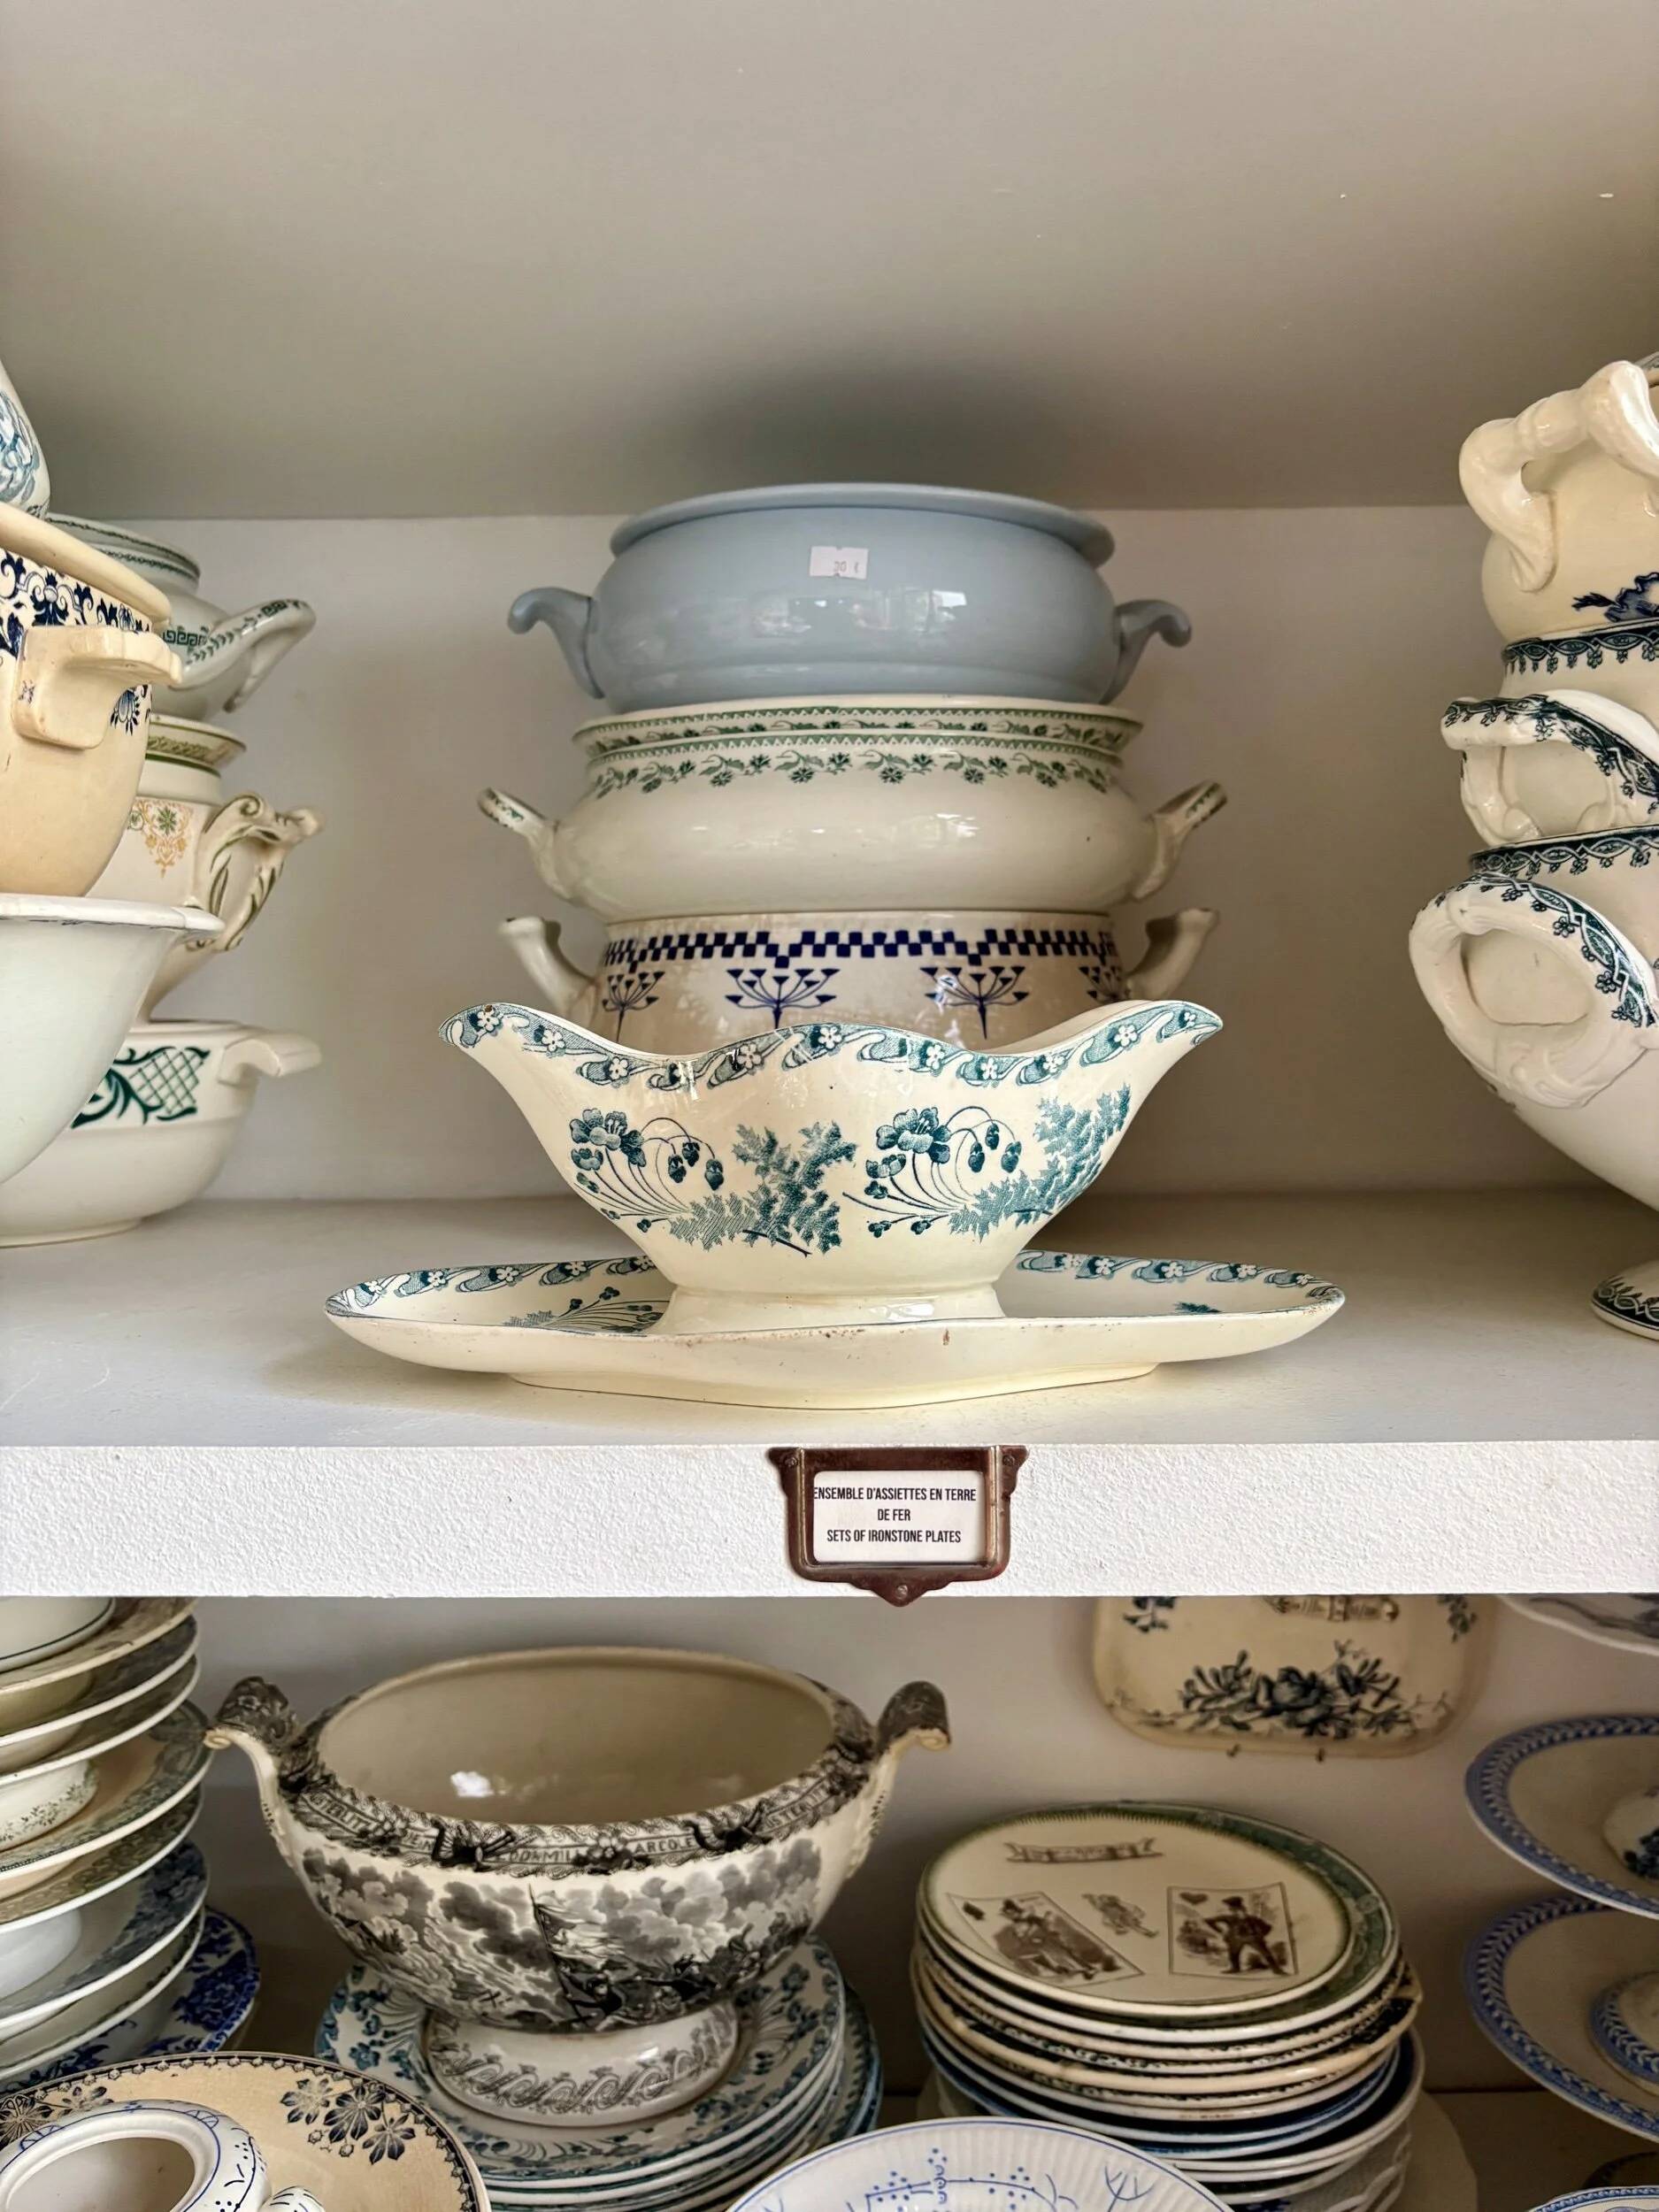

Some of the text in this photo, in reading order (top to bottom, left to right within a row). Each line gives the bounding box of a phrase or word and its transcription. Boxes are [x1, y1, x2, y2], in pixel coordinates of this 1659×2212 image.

[813, 1486, 977, 1502] ENSEMBLE D'ASSIETTES EN TERRE
[877, 1509, 911, 1522] DE FER
[826, 1529, 962, 1544] SETS OF IRONSTONE PLATES
